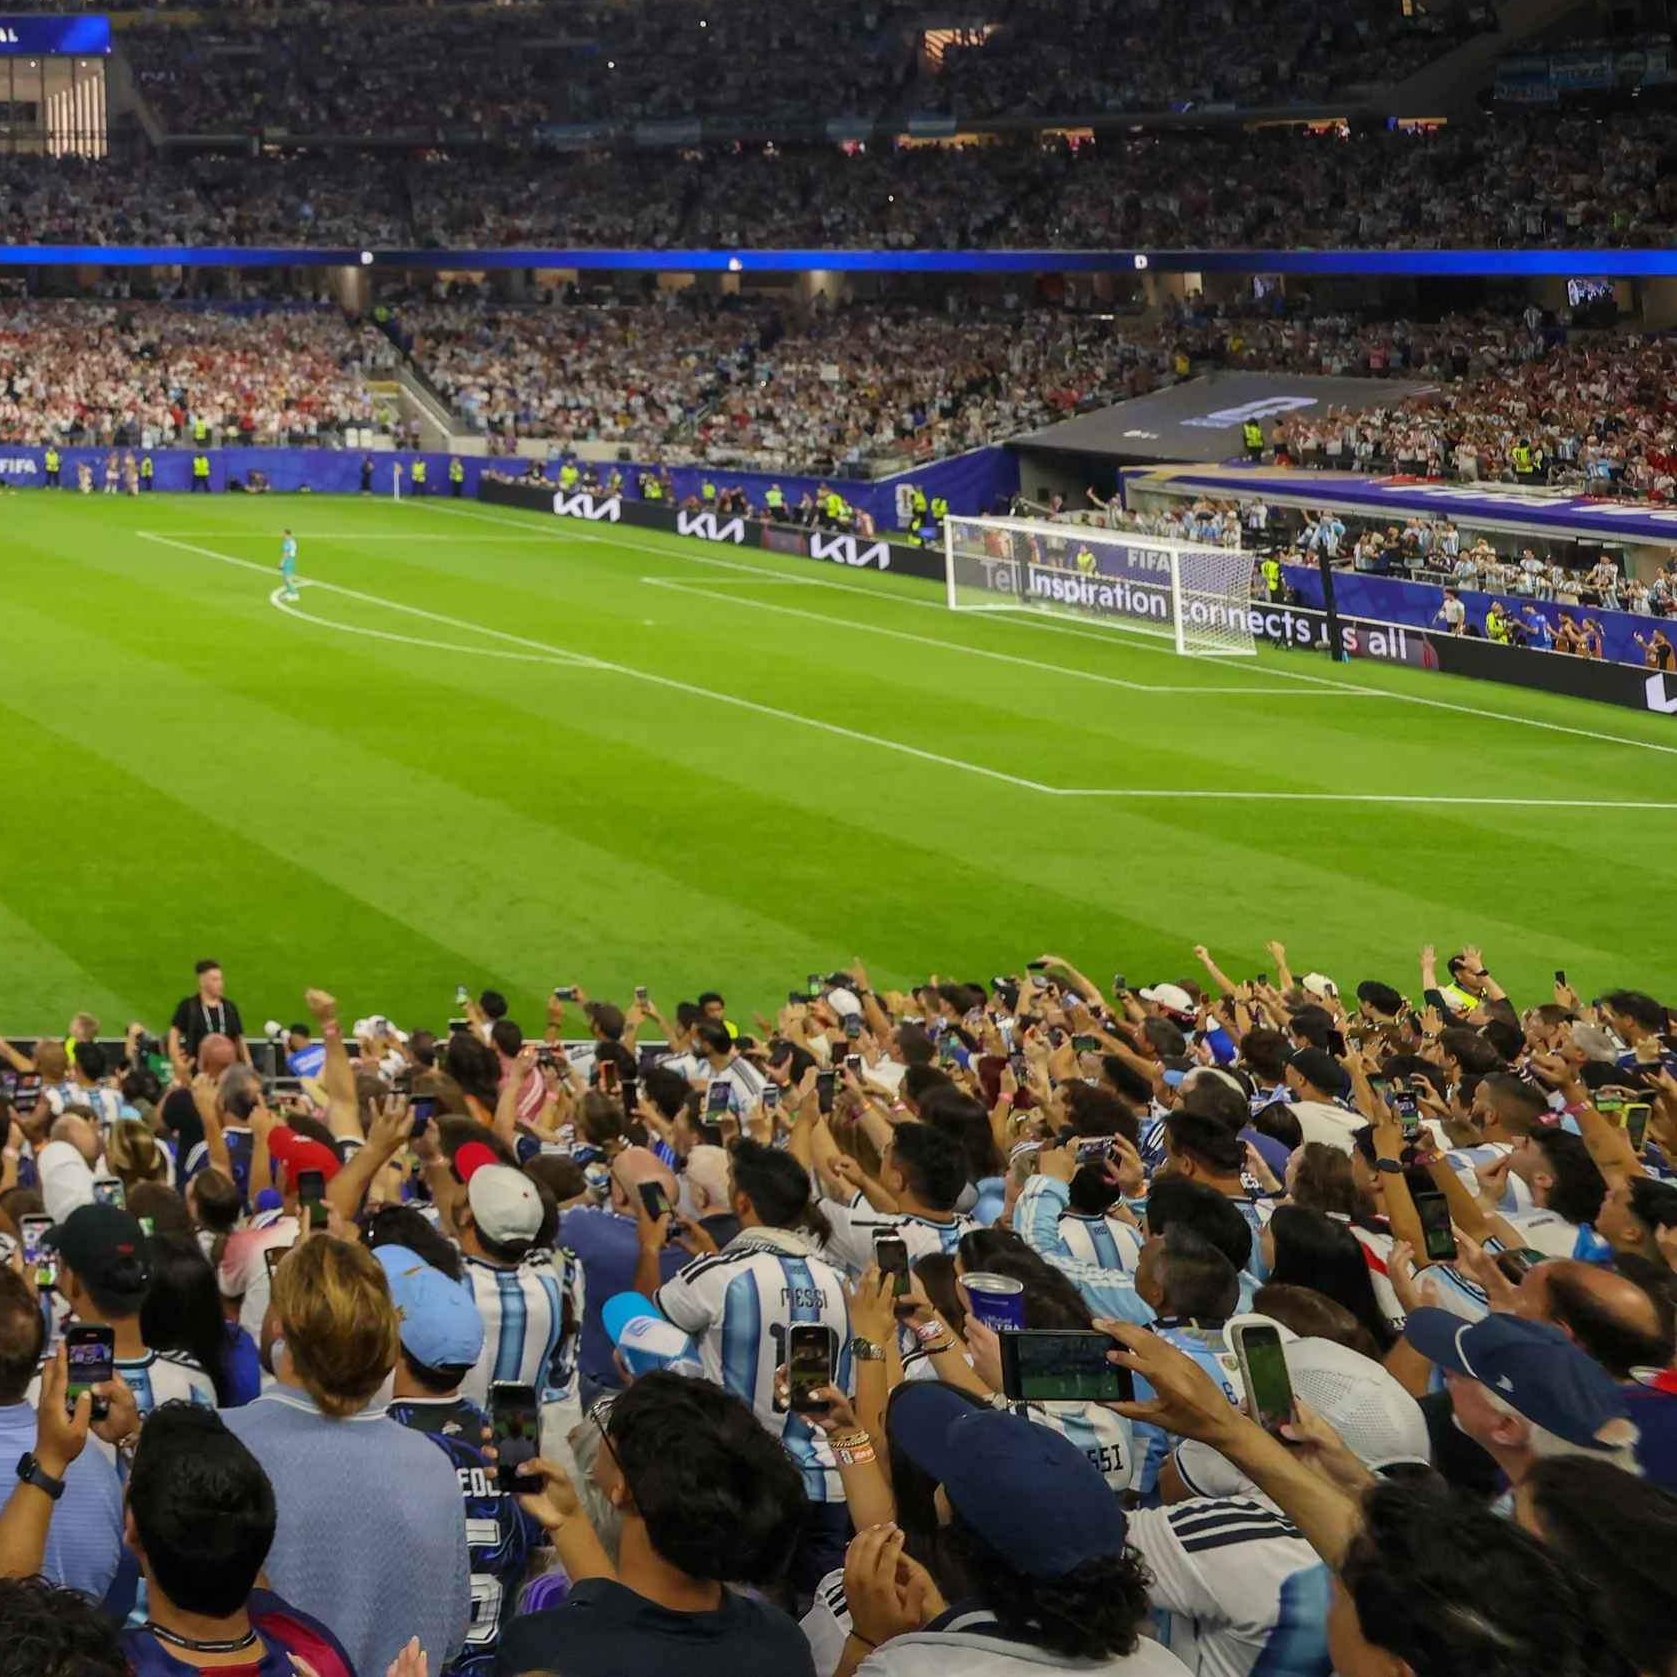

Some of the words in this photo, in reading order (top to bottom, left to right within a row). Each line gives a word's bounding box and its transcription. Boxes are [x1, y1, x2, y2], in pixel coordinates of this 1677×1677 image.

[1127, 547, 1171, 572] FIFA
[1028, 567, 1167, 618] Inspiration
[1368, 625, 1408, 660] all
[780, 1288, 828, 1309] MESSI
